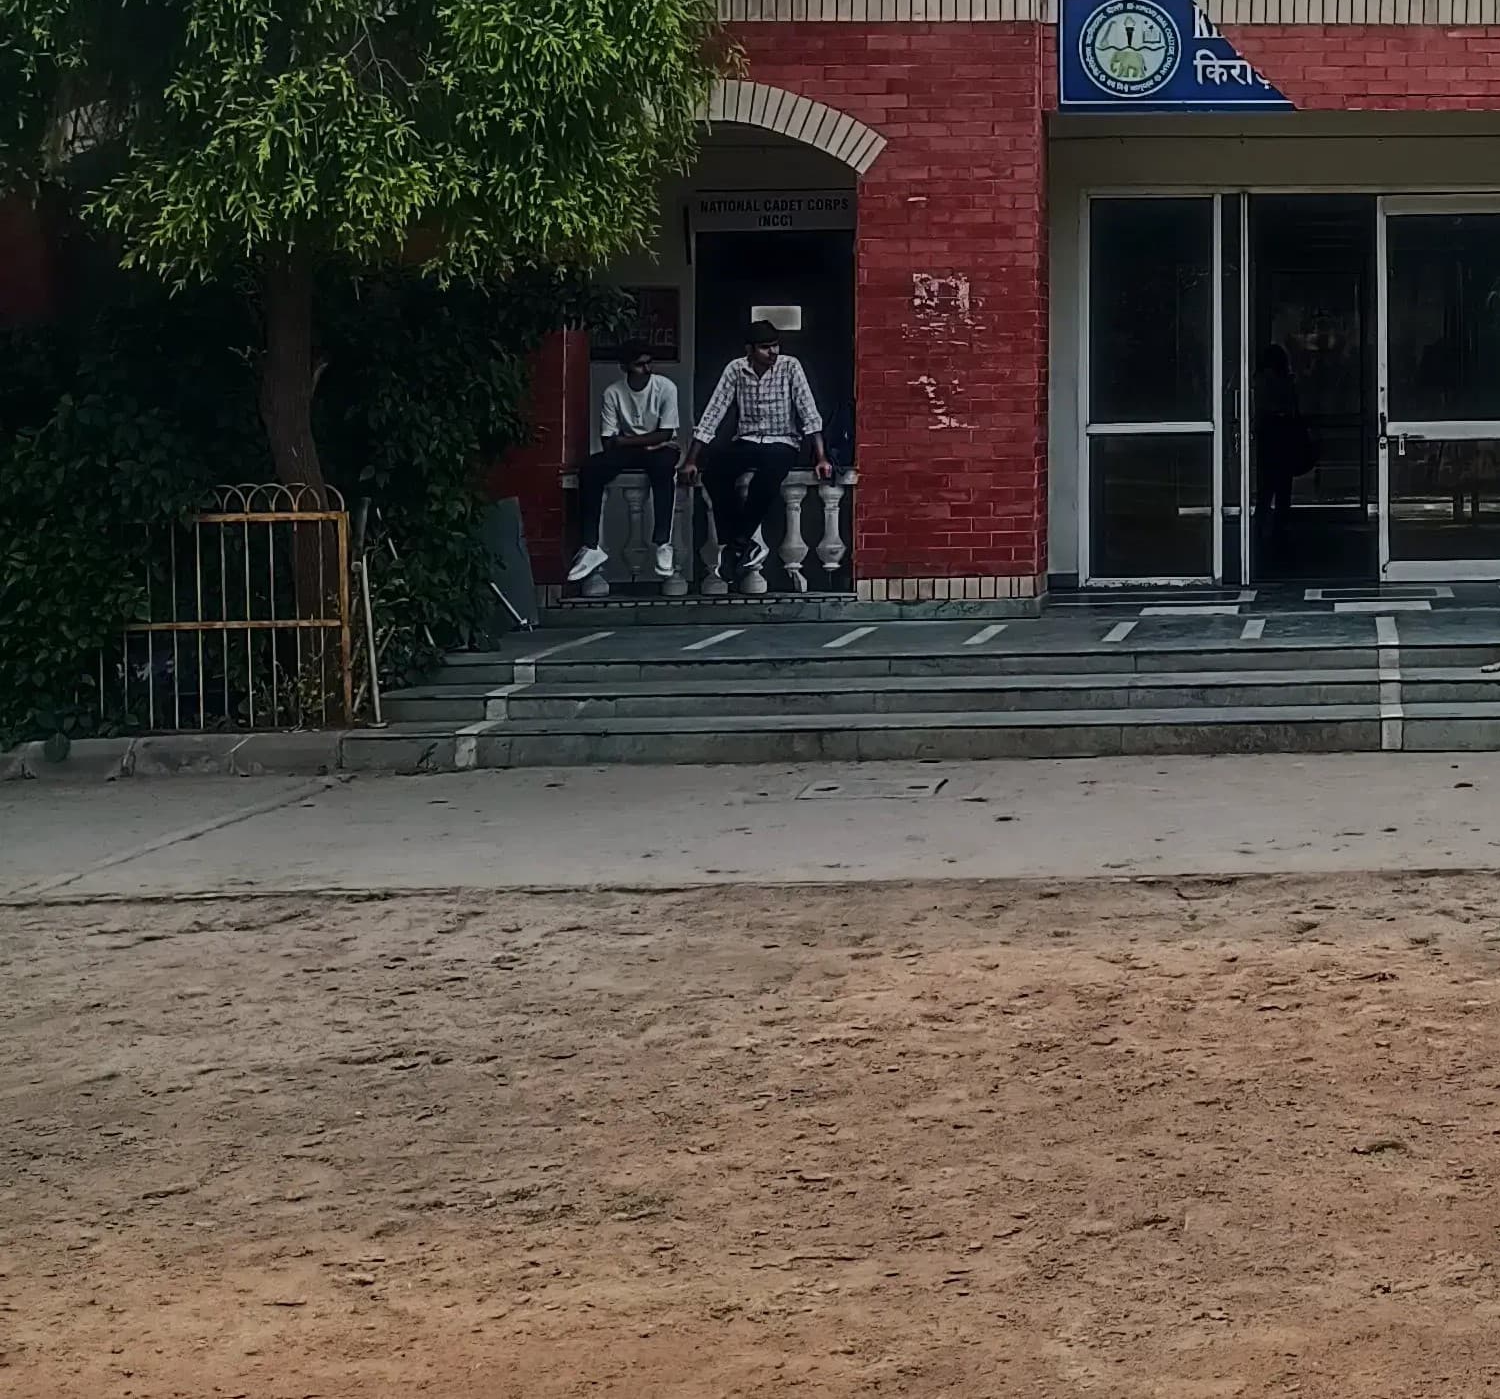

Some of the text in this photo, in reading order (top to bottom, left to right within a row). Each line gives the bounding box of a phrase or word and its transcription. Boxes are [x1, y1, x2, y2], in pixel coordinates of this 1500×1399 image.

[701, 197, 849, 213] NATIONAL CADET CORPS
